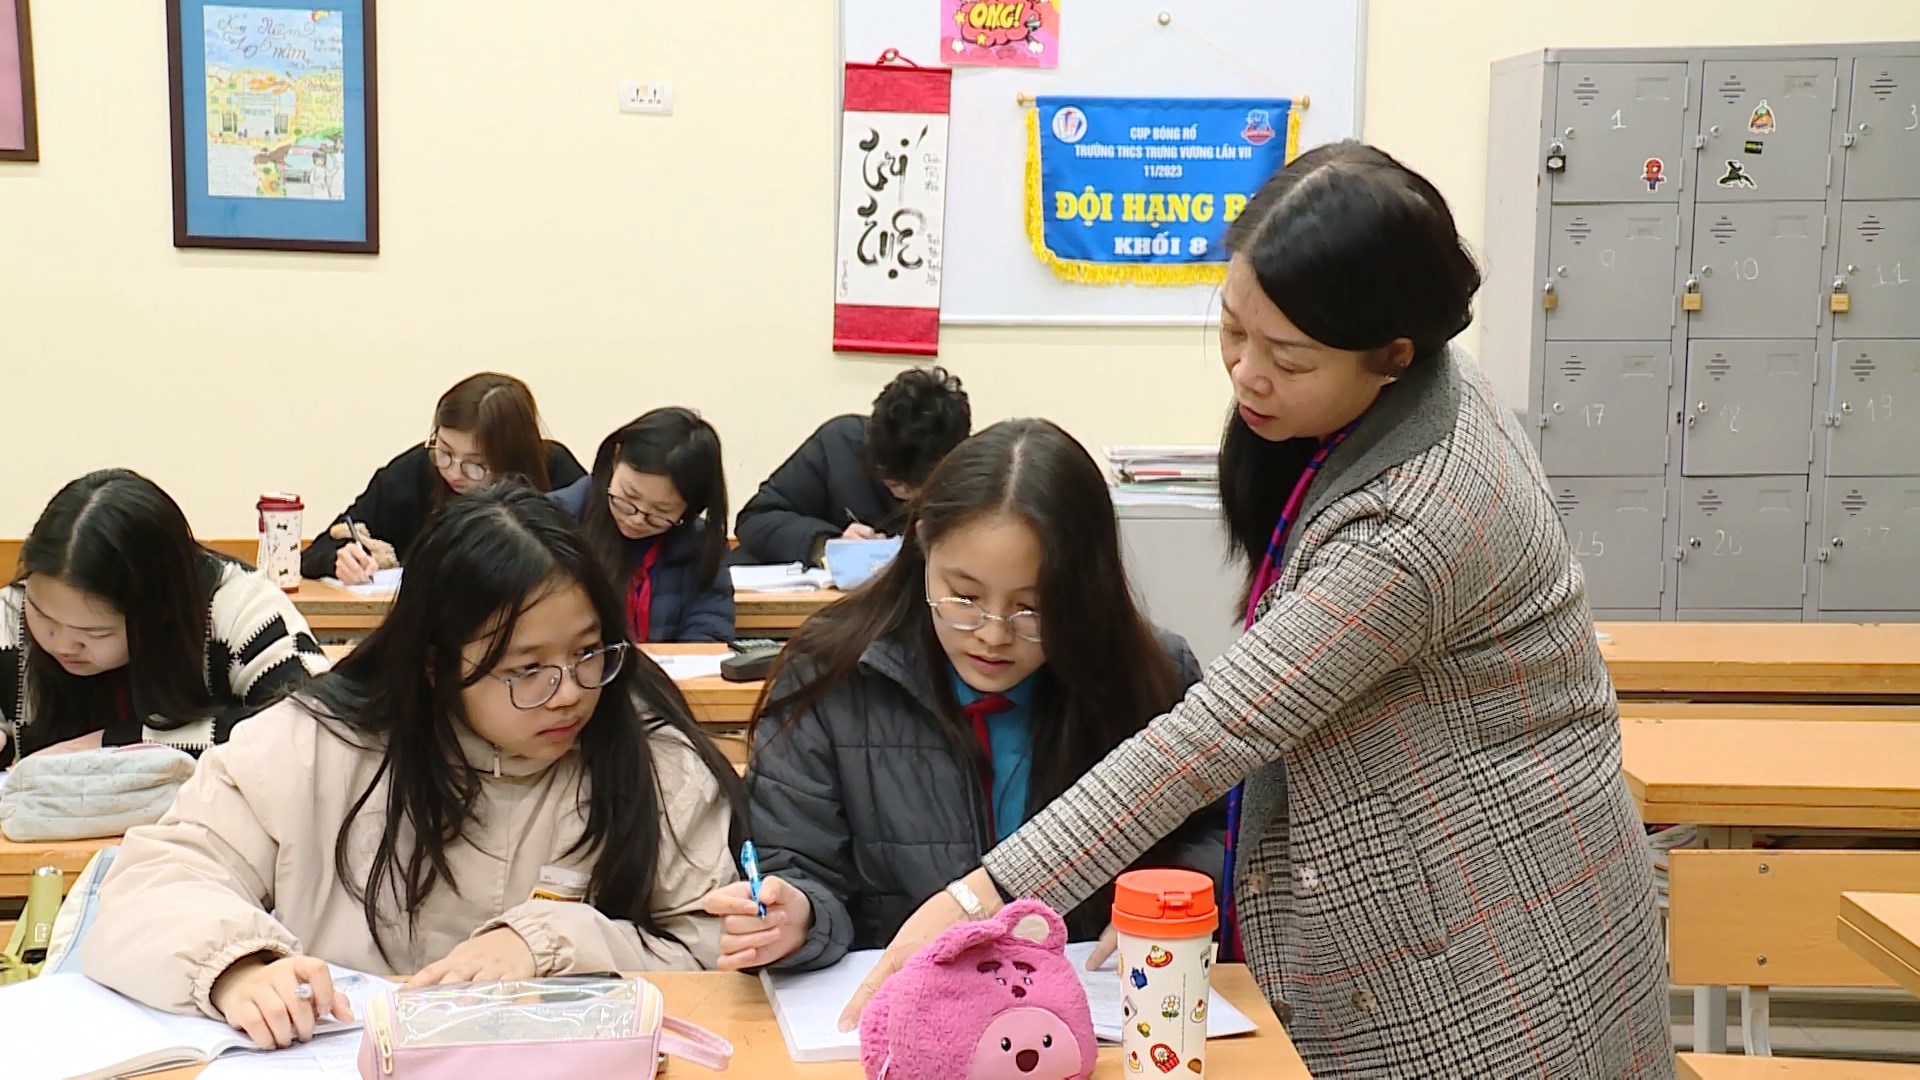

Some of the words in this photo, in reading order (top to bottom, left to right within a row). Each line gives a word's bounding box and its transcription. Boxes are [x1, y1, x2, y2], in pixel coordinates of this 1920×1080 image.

[969, 2, 1024, 30] OMG!
[1611, 108, 1627, 129] 1
[1903, 104, 1919, 130] 3
[1130, 126, 1151, 140] CUP
[1152, 125, 1181, 141] BÓNG
[1074, 142, 1115, 159] TRƯỜNG
[1117, 144, 1143, 159] THCS
[1238, 146, 1252, 160] VII
[1144, 164, 1183, 179] 11/2023
[1055, 185, 1113, 227] ĐỘI
[1122, 193, 1214, 228] HẠNG
[1223, 193, 1254, 222] B
[1114, 231, 1181, 256] KHỐI
[1188, 237, 1209, 256] 8
[1733, 256, 1759, 281] 10
[1872, 262, 1910, 288] 11
[1581, 402, 1605, 427] 17
[1866, 394, 1893, 423] 19
